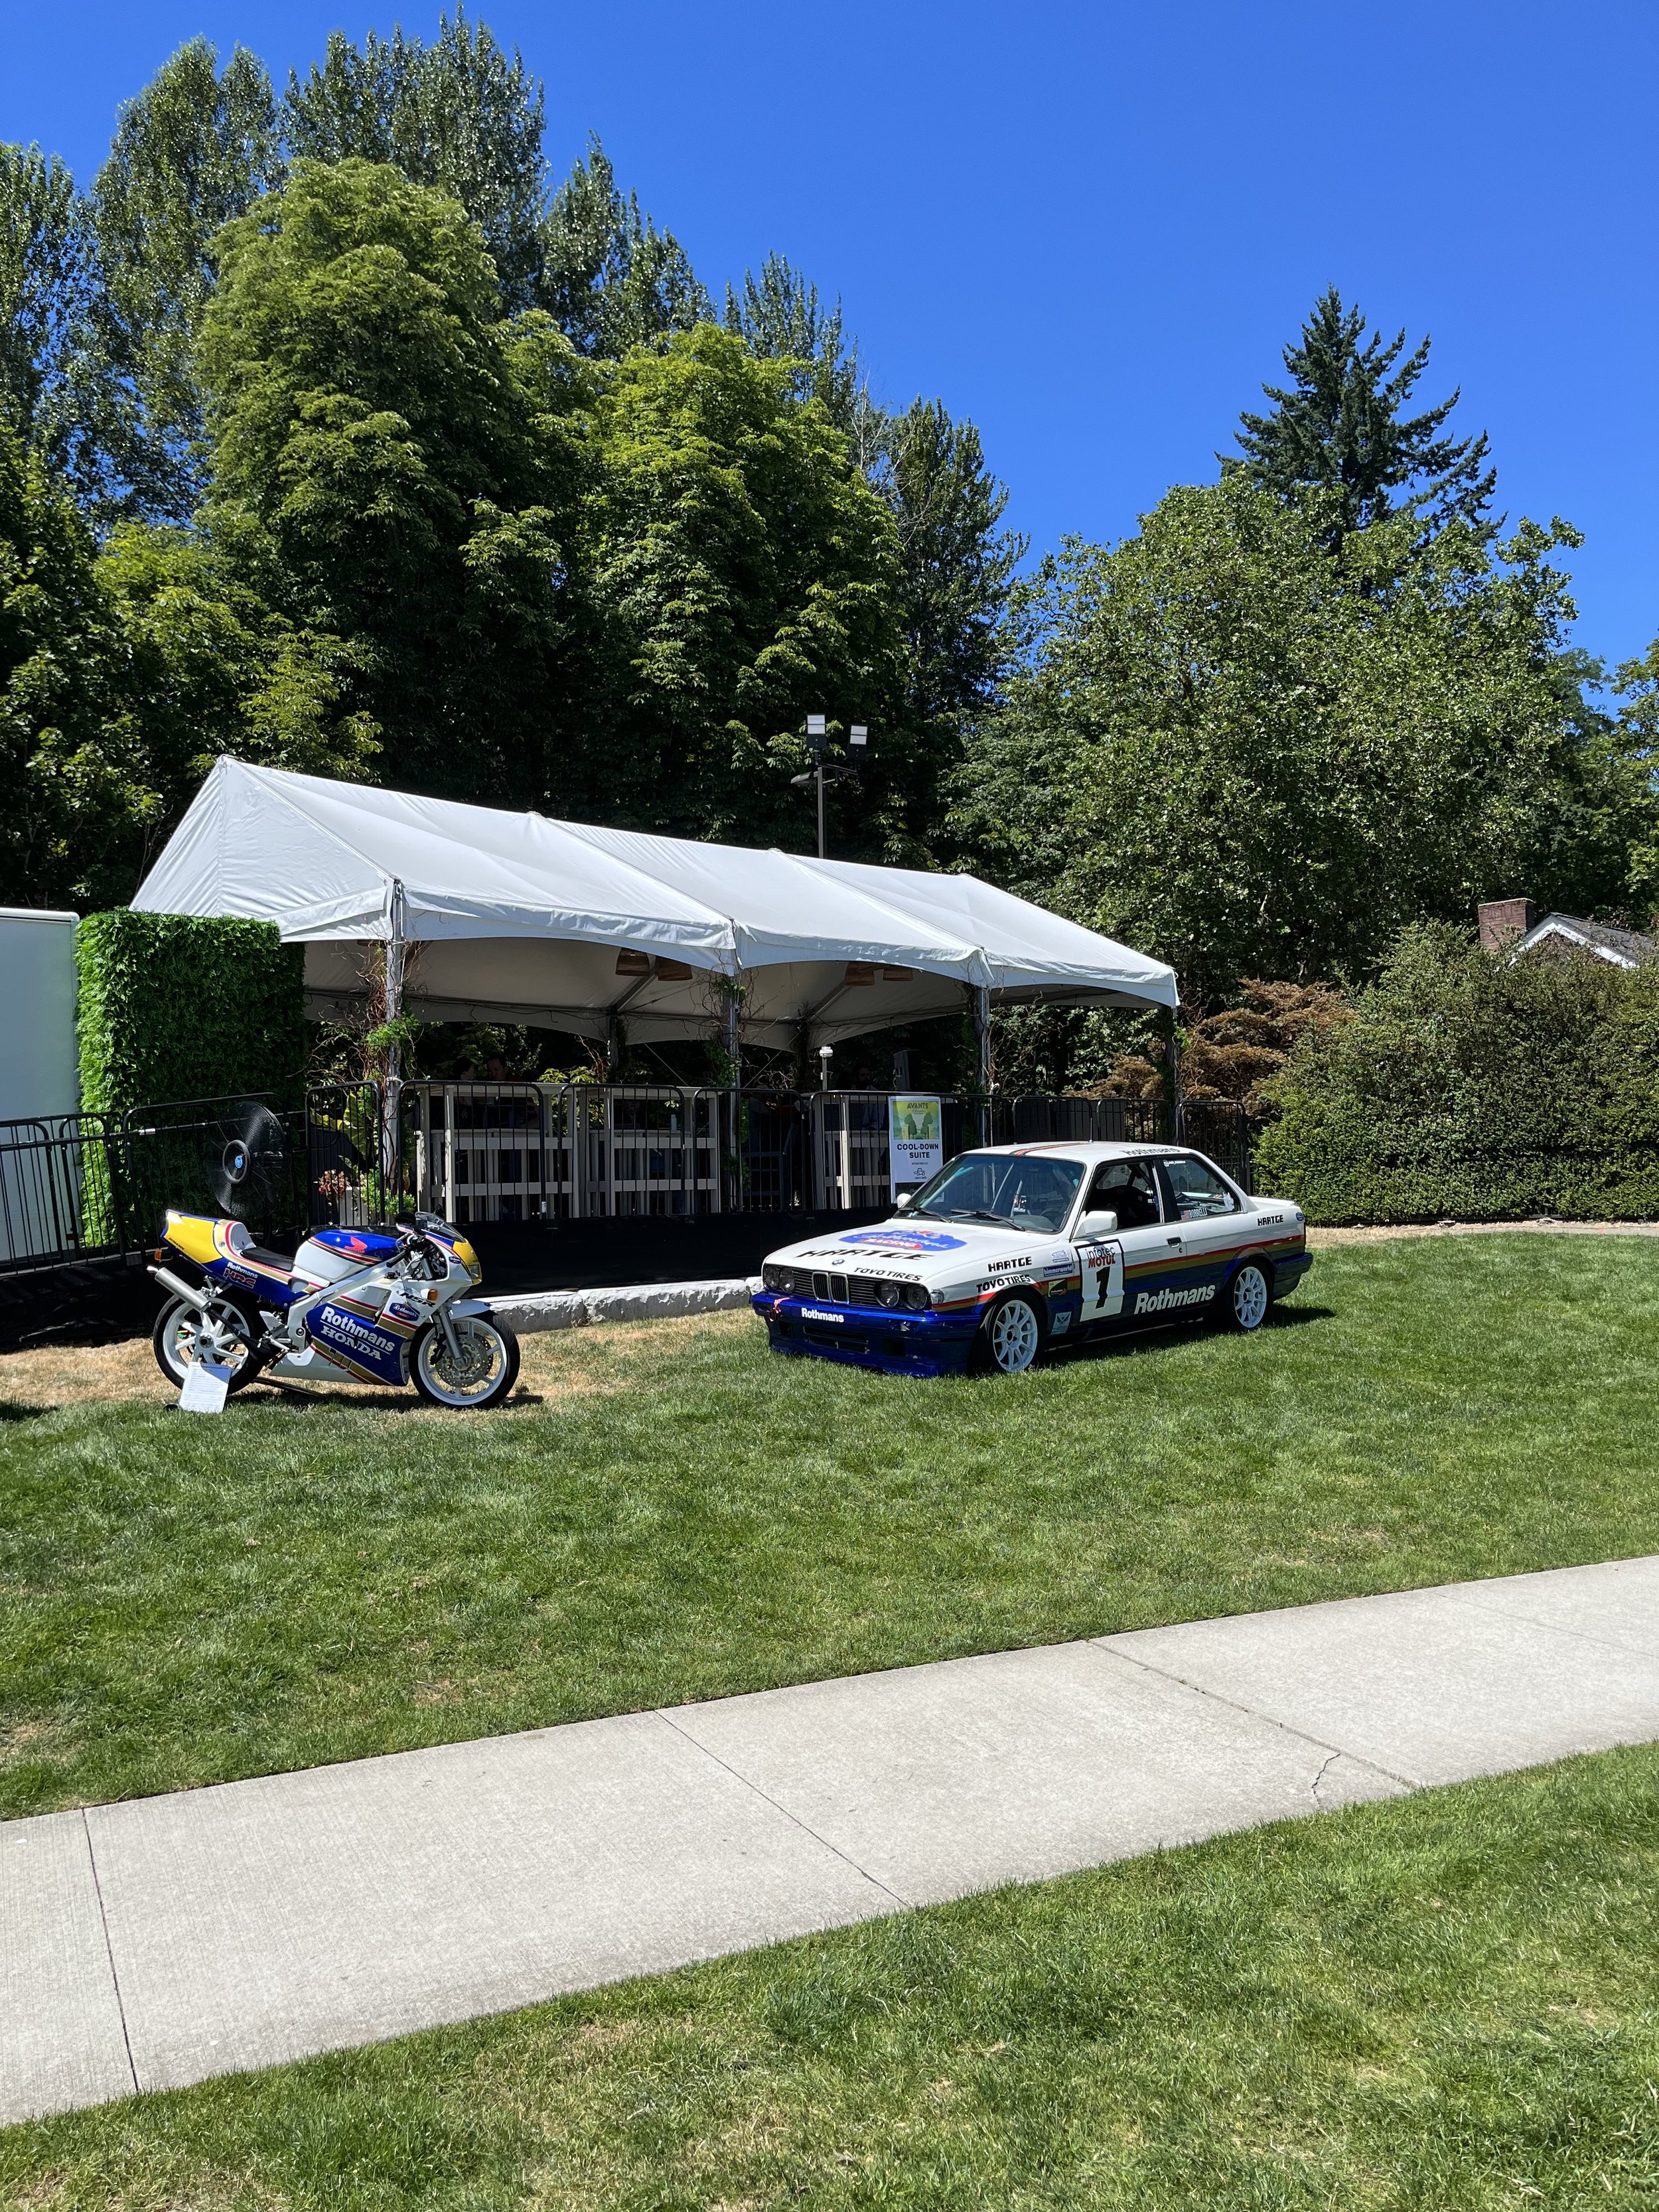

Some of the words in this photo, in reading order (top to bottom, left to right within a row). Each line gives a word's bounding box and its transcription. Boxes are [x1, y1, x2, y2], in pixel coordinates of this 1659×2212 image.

[1257, 1215, 1284, 1226] HARTGE
[795, 1250, 935, 1260] HARTGE
[1085, 1247, 1116, 1260] infotec
[987, 1256, 1033, 1272] HARTGE
[1088, 1256, 1116, 1268] MOTUL
[223, 1268, 256, 1289] HRC
[227, 1262, 258, 1279] Rothmans
[885, 1271, 923, 1282] TIRES
[976, 1278, 1005, 1293] TOYO
[1005, 1274, 1031, 1285] TIRES
[1096, 1266, 1110, 1309] 1
[399, 1292, 436, 1307] NSR
[1133, 1285, 1216, 1315] Rothmans
[801, 1307, 845, 1323] Rothmans
[321, 1306, 396, 1352] Rothmans
[321, 1325, 382, 1360] HONDA
